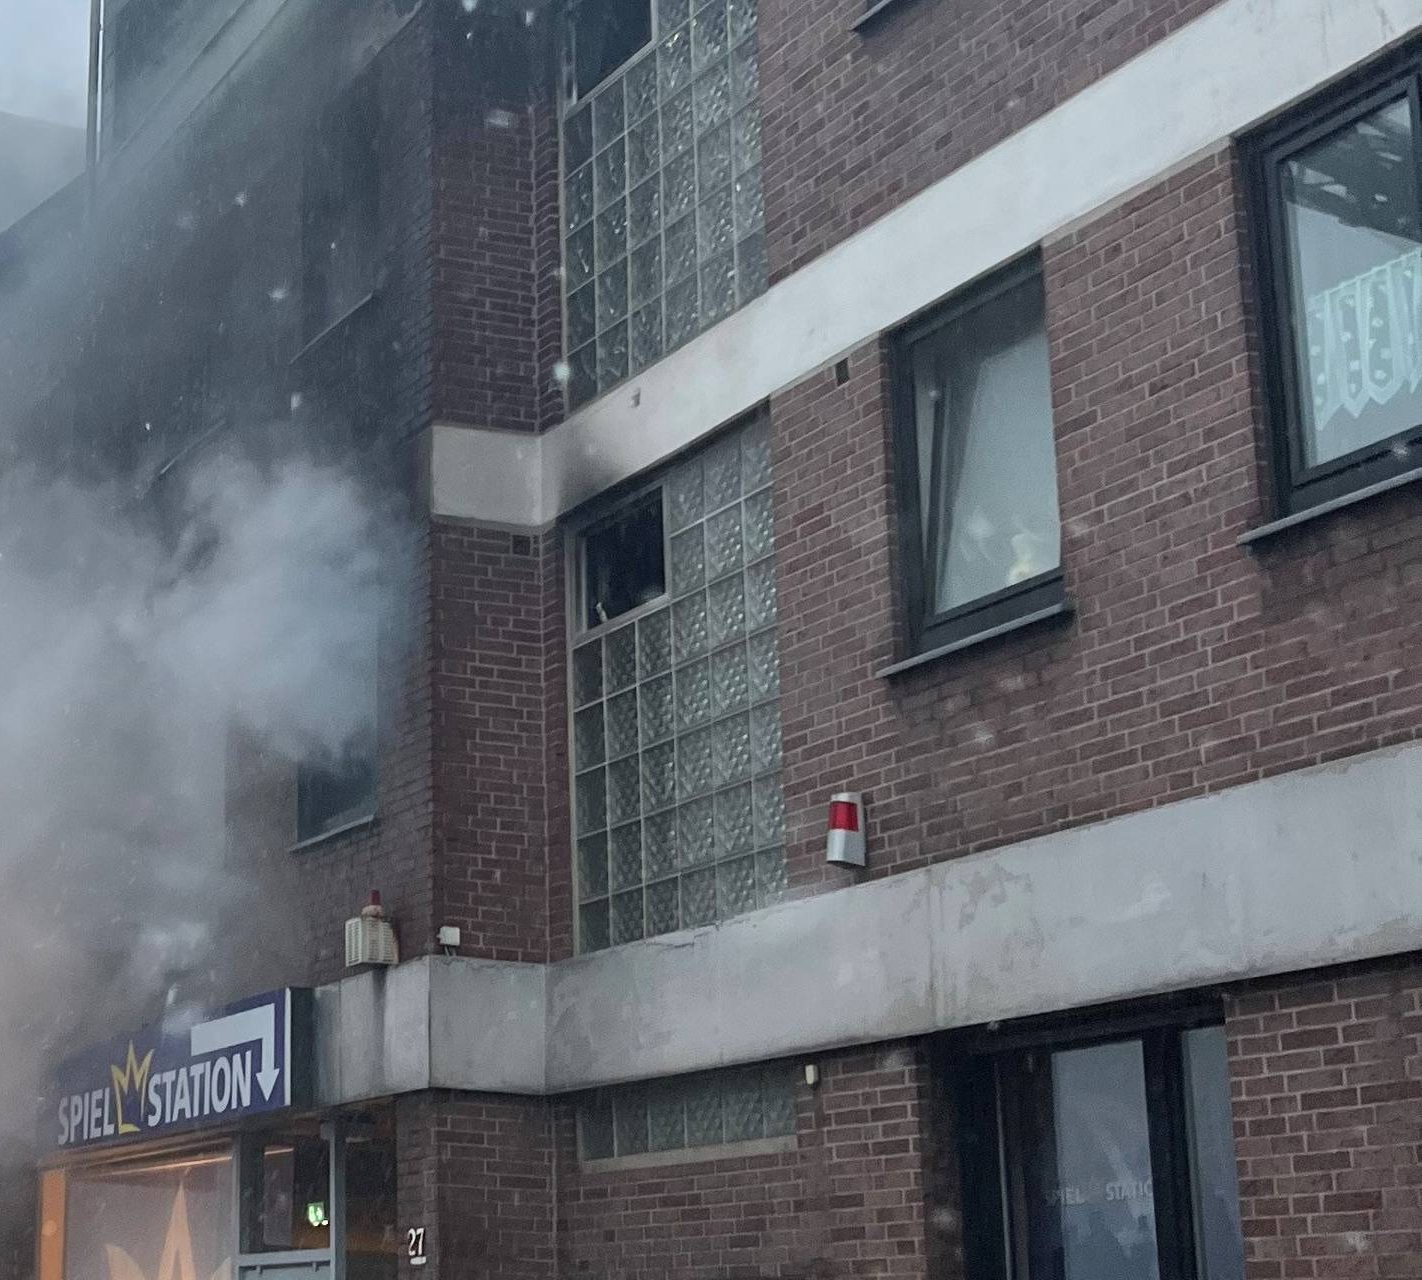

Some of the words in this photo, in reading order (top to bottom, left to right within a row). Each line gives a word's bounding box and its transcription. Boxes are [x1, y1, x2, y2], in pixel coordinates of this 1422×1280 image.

[57, 1087, 115, 1145] SPIEL
[147, 1050, 252, 1127] STATION
[407, 1227, 425, 1256] 27
